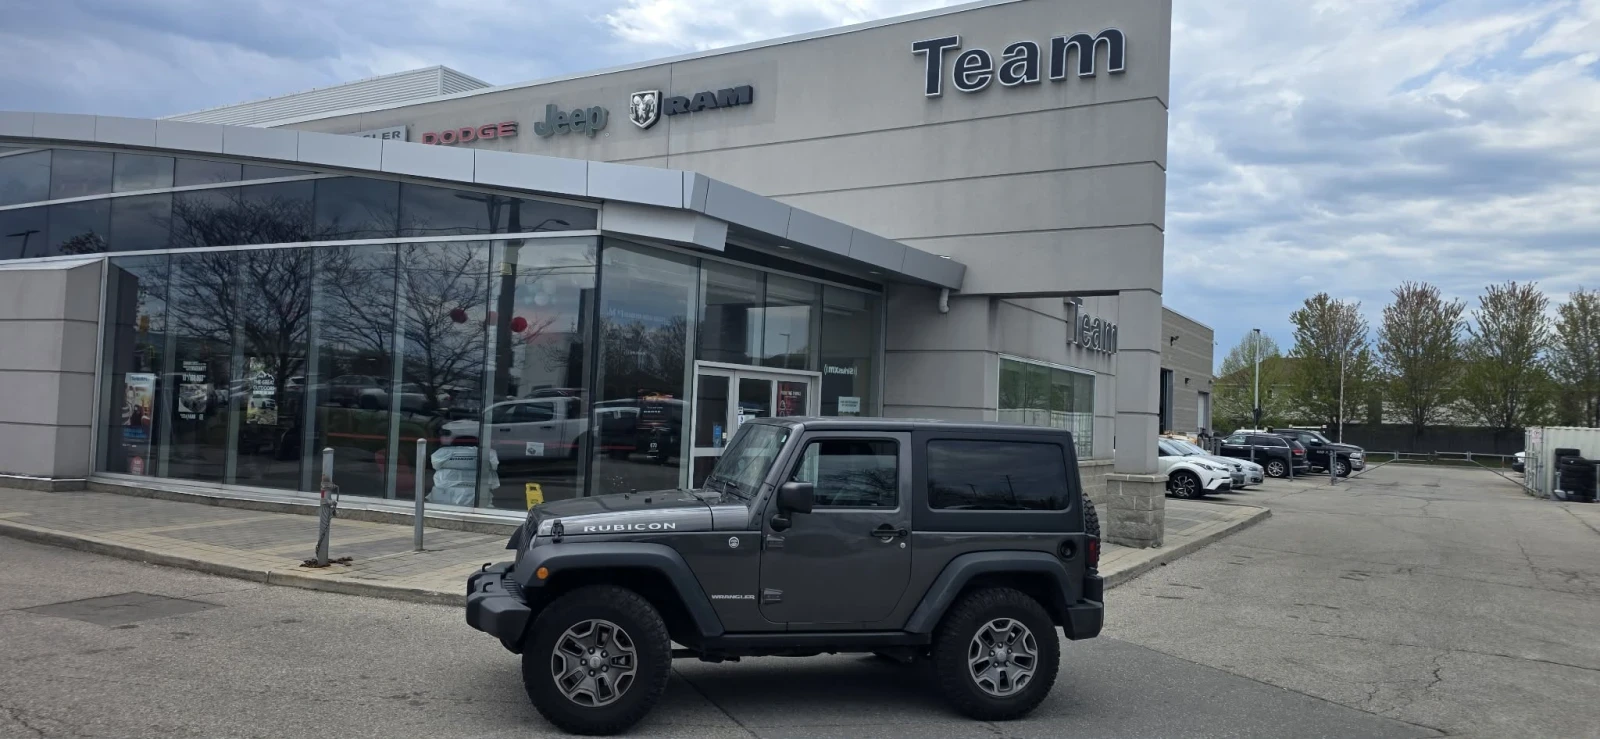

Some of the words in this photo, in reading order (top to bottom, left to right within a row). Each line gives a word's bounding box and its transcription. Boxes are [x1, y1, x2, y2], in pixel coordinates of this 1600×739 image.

[911, 27, 1126, 98] Team
[664, 85, 754, 116] RAM
[422, 121, 518, 146] DODGE
[534, 104, 609, 138] Jeep
[1065, 296, 1118, 354] Team
[583, 522, 677, 533] RUBICON
